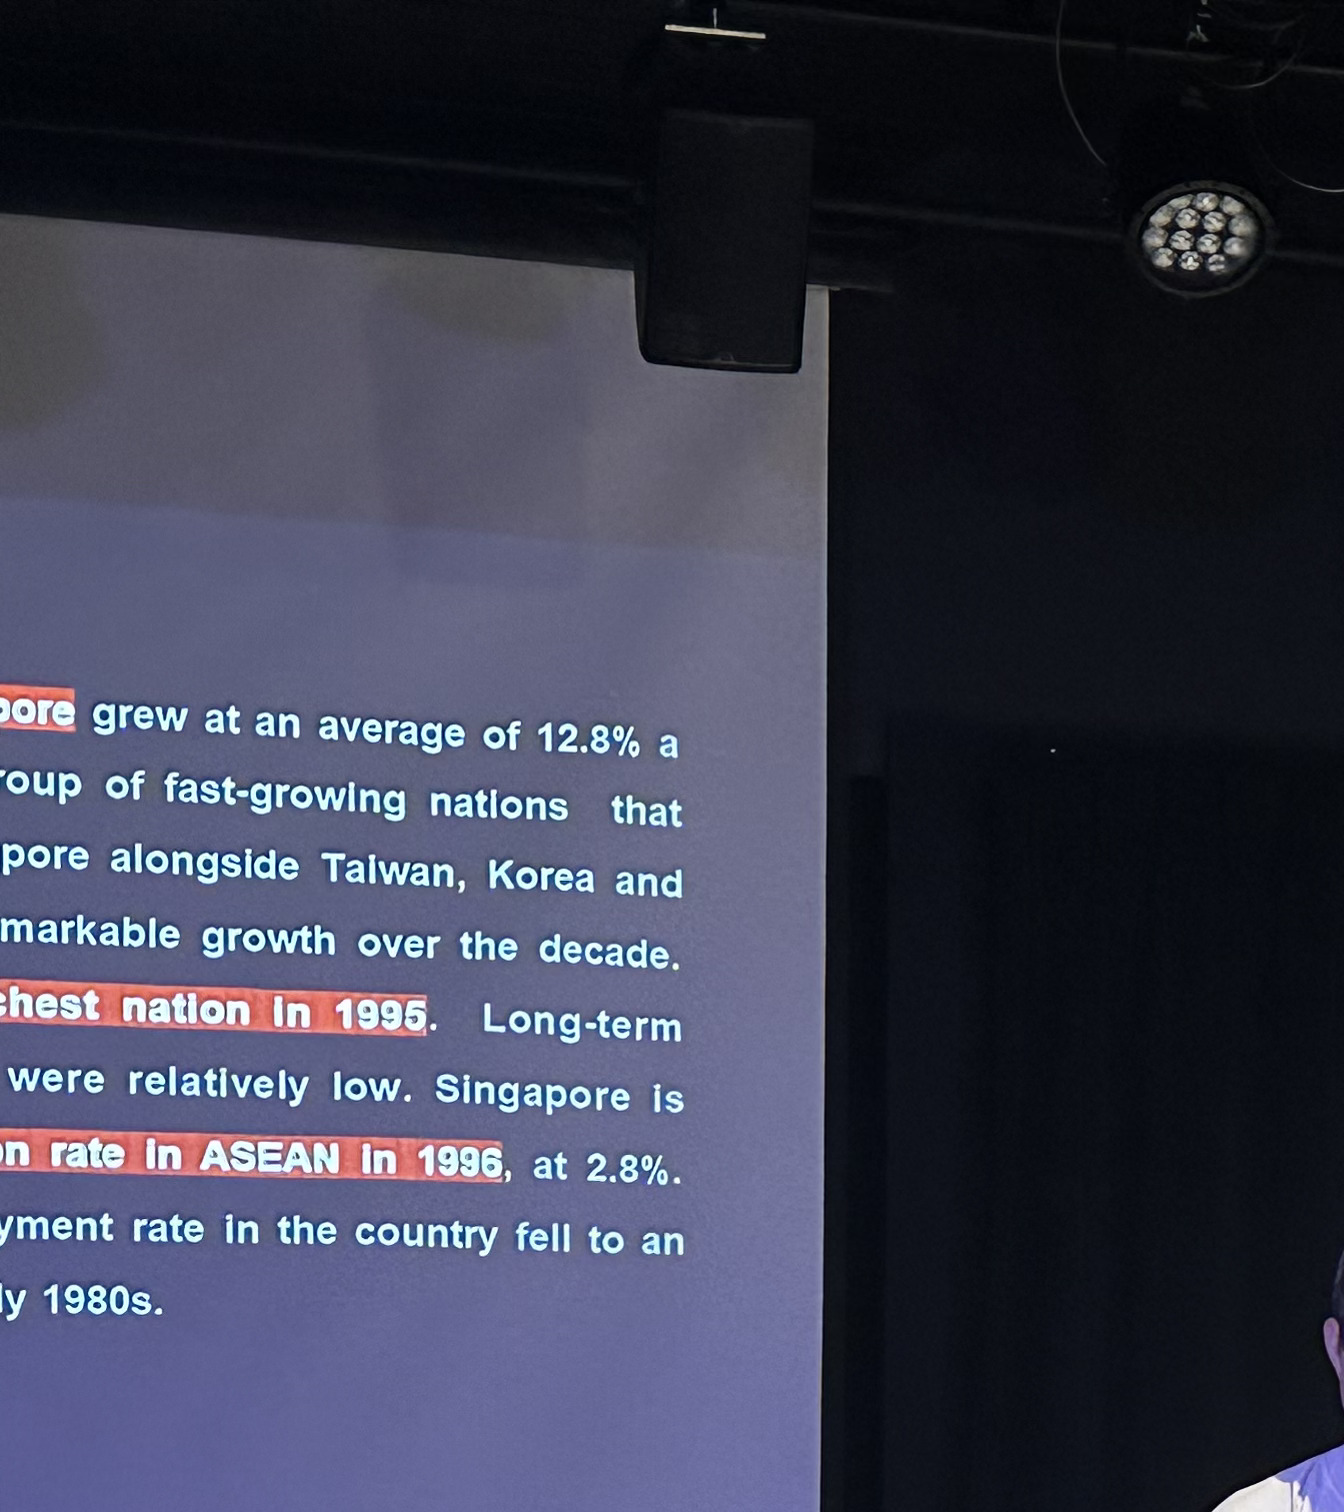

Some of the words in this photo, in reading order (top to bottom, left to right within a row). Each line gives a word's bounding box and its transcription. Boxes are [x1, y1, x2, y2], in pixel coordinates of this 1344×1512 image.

[92, 703, 189, 736] grew
[204, 704, 241, 735] at
[255, 711, 301, 739] an
[318, 715, 466, 755] average
[482, 720, 522, 751] of
[537, 721, 641, 759] 12.8%
[659, 734, 679, 759] a
[105, 769, 146, 801] of
[163, 771, 406, 822] fast-growing
[430, 788, 569, 821] nations
[610, 794, 683, 828] that
[2, 843, 90, 876] pore
[110, 842, 300, 885] alongside
[320, 852, 466, 894] Taiwan,
[488, 859, 595, 894] Korea
[615, 868, 683, 899] and
[0, 914, 181, 949] markable
[202, 924, 336, 959] growth
[357, 933, 442, 959] over
[459, 930, 519, 962] the
[539, 933, 680, 971] decade.
[122, 992, 251, 1026] nation
[273, 995, 311, 1029] in
[335, 998, 438, 1036] 1995.
[483, 1002, 682, 1045] Long-term
[7, 1067, 105, 1094] were
[129, 1065, 310, 1108] relatively
[333, 1070, 412, 1103] low.
[435, 1073, 631, 1116] Singapore
[653, 1083, 685, 1114] is
[50, 1137, 126, 1169] rate
[146, 1137, 182, 1170] in
[199, 1139, 340, 1174] ASEAN
[362, 1143, 397, 1175] in
[418, 1144, 512, 1183] 1996,
[533, 1151, 568, 1181] at
[586, 1152, 681, 1186] 2.8%.
[133, 1213, 205, 1243] rate
[225, 1213, 260, 1245] in
[276, 1214, 338, 1245] the
[355, 1220, 499, 1257] country
[515, 1221, 571, 1253] fell
[587, 1225, 625, 1255] to
[641, 1232, 685, 1256] an
[43, 1283, 163, 1316] 1980s.
